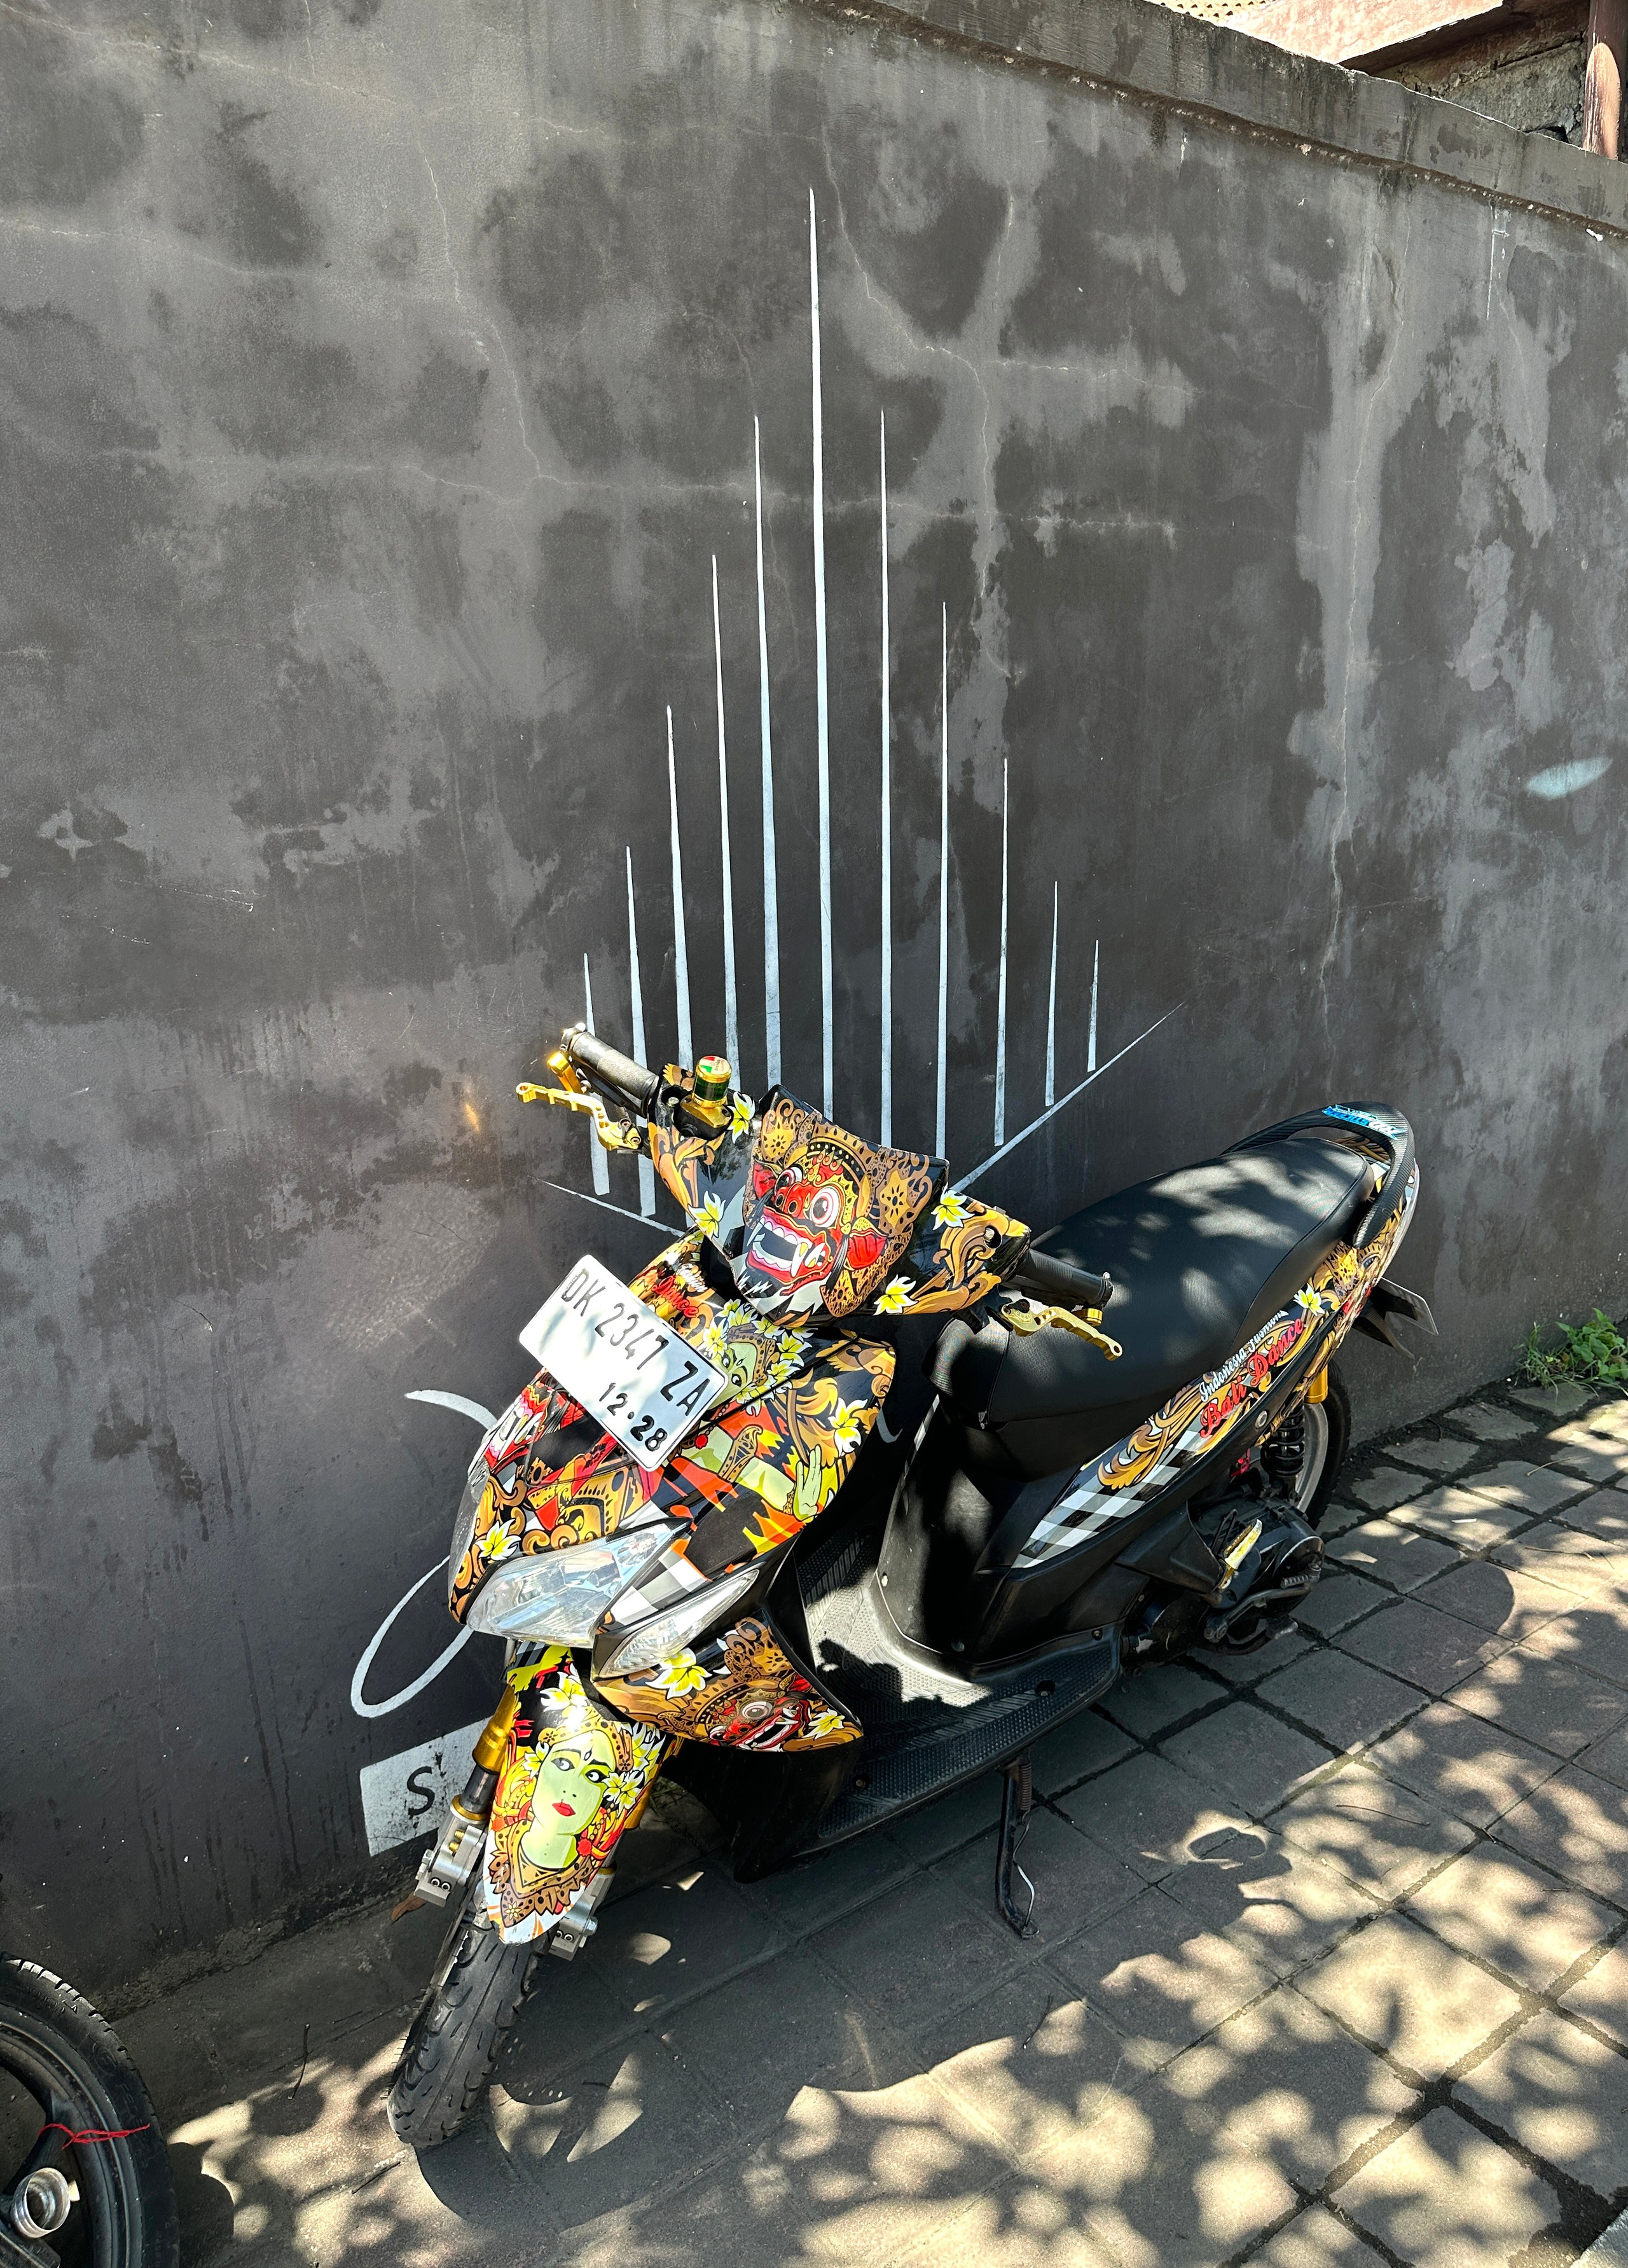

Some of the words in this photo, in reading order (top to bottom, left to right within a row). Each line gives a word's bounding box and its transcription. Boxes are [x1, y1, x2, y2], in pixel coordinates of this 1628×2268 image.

[651, 1275, 700, 1318] Dance
[675, 1263, 708, 1292] Fashion
[561, 1268, 606, 1317] DK
[595, 1303, 669, 1370] 2347
[661, 1360, 710, 1416] ZA
[1199, 1348, 1247, 1402] Indonesia
[1200, 1375, 1247, 1438] Bali
[1247, 1318, 1304, 1386] Dance
[599, 1382, 668, 1452] 12.28
